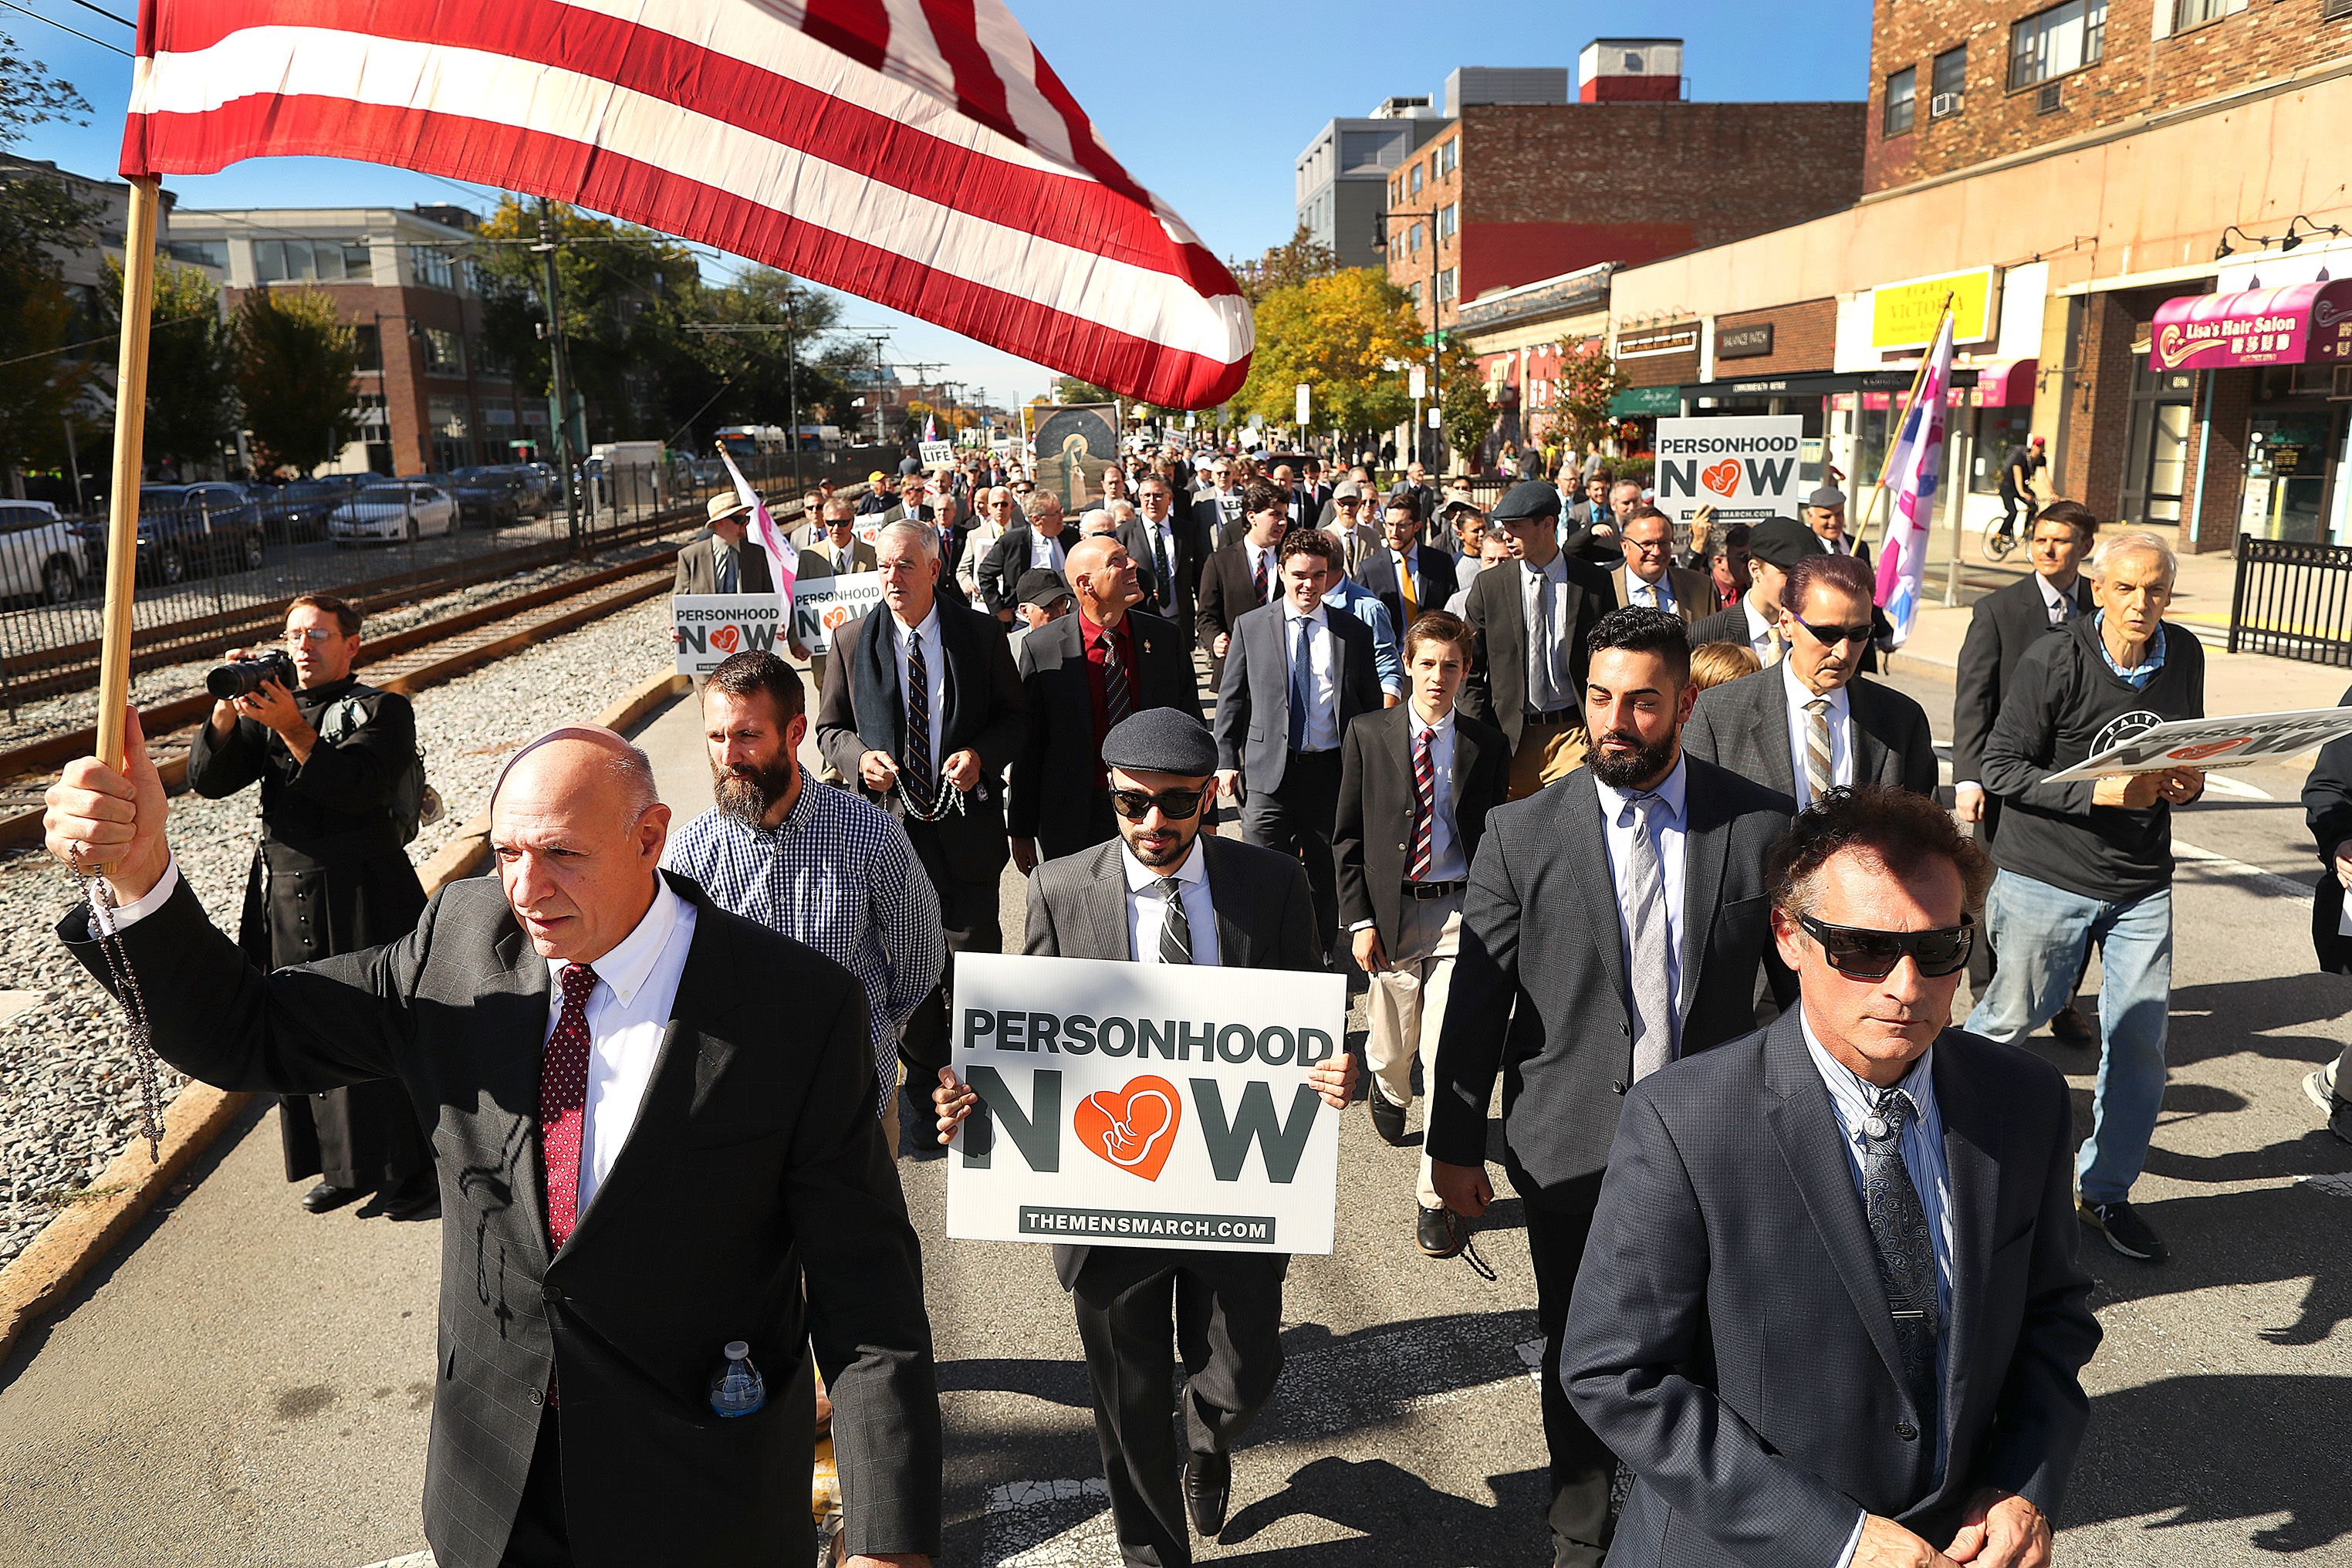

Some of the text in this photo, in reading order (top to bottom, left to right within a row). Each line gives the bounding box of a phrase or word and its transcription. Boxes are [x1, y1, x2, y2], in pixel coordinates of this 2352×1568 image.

[1891, 296, 1964, 319] VICTORA
[2186, 316, 2296, 340] Lisa's Hair Salon
[923, 451, 951, 462] LIFE
[1661, 437, 1798, 454] PERSONHOOD
[795, 586, 880, 607] PERSONHOOD
[676, 608, 779, 621] PERSONHOOD
[2130, 718, 2352, 745] PERSONHOO
[964, 1008, 1333, 1067] PERSONHOOD
[1026, 1213, 1267, 1239] THEMENSMARCH.COM
